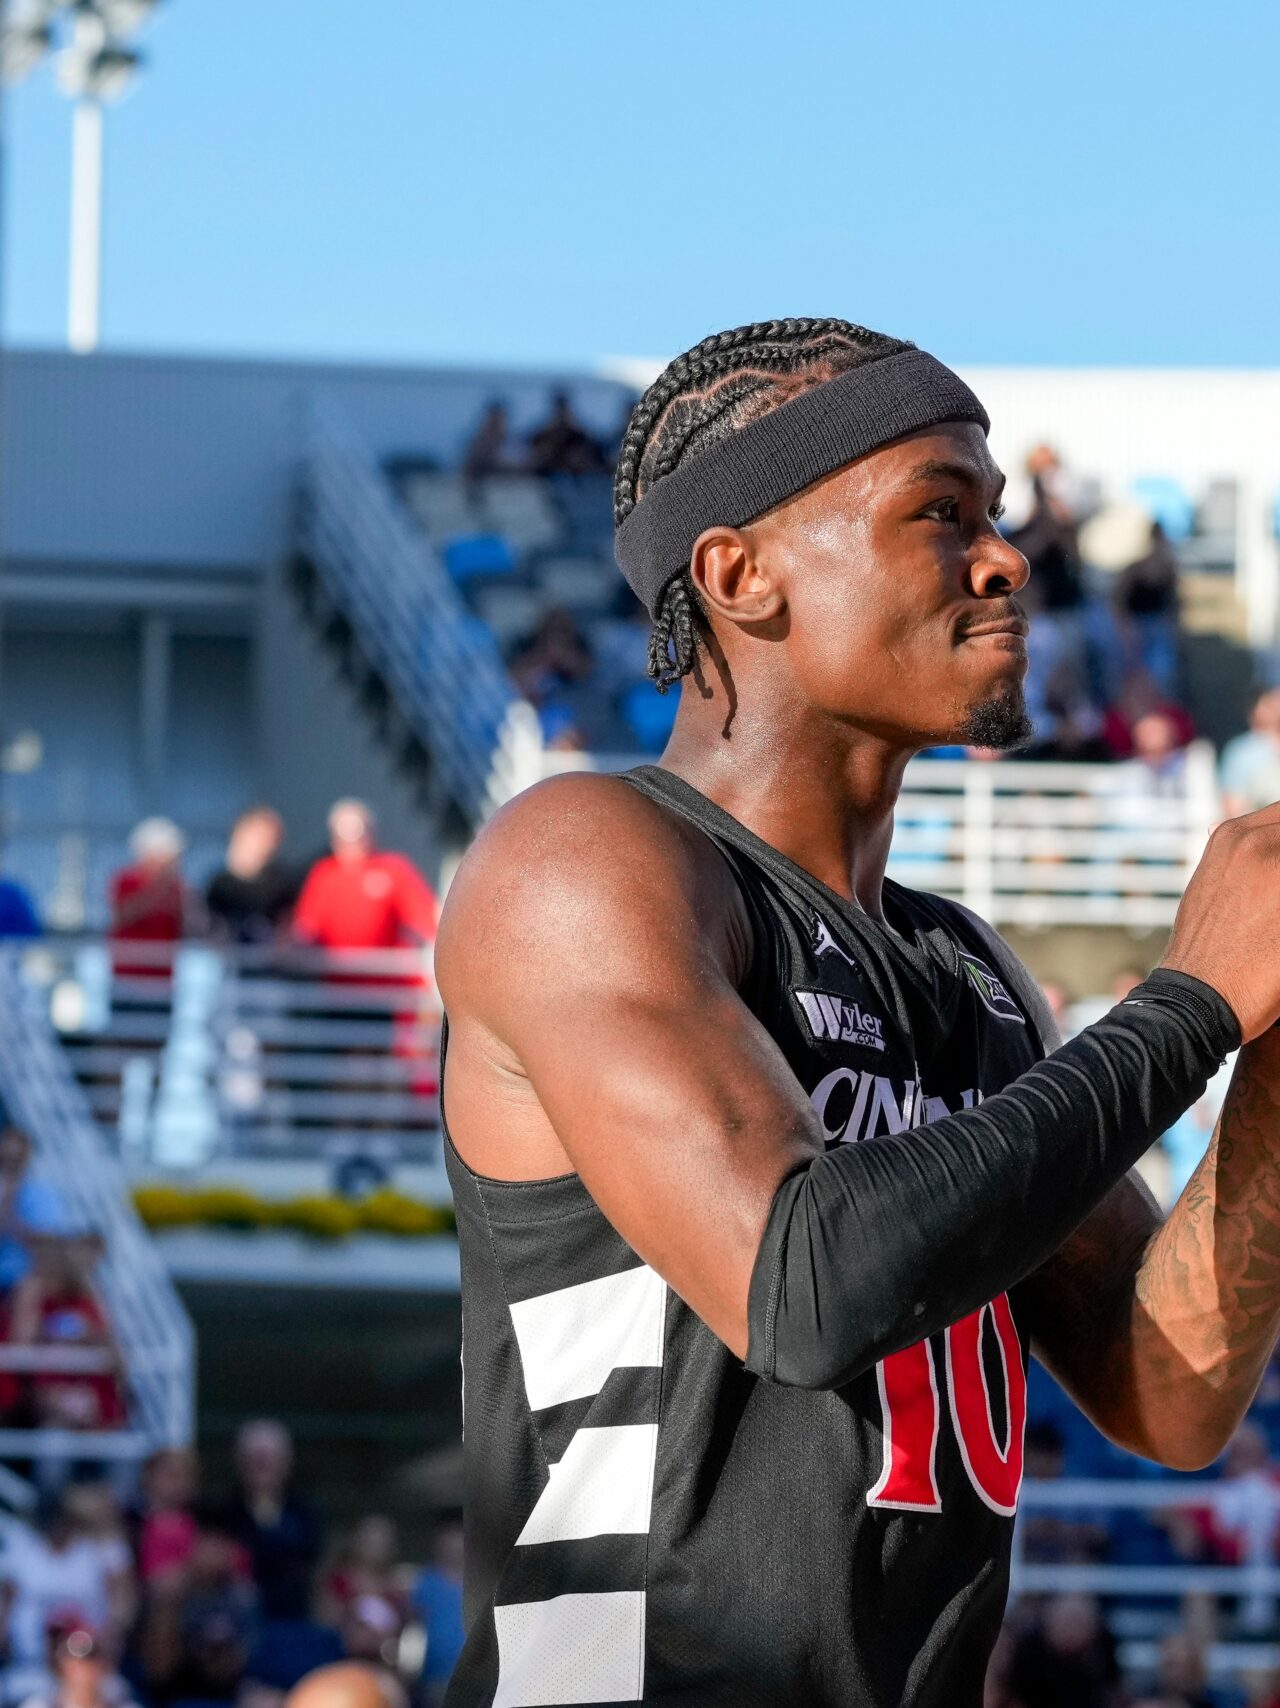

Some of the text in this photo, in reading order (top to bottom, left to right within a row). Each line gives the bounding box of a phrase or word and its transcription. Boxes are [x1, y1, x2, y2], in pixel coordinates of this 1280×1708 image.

[795, 992, 883, 1039] Wyler
[811, 1067, 985, 1142] CIN
[866, 1290, 1027, 1517] 10
